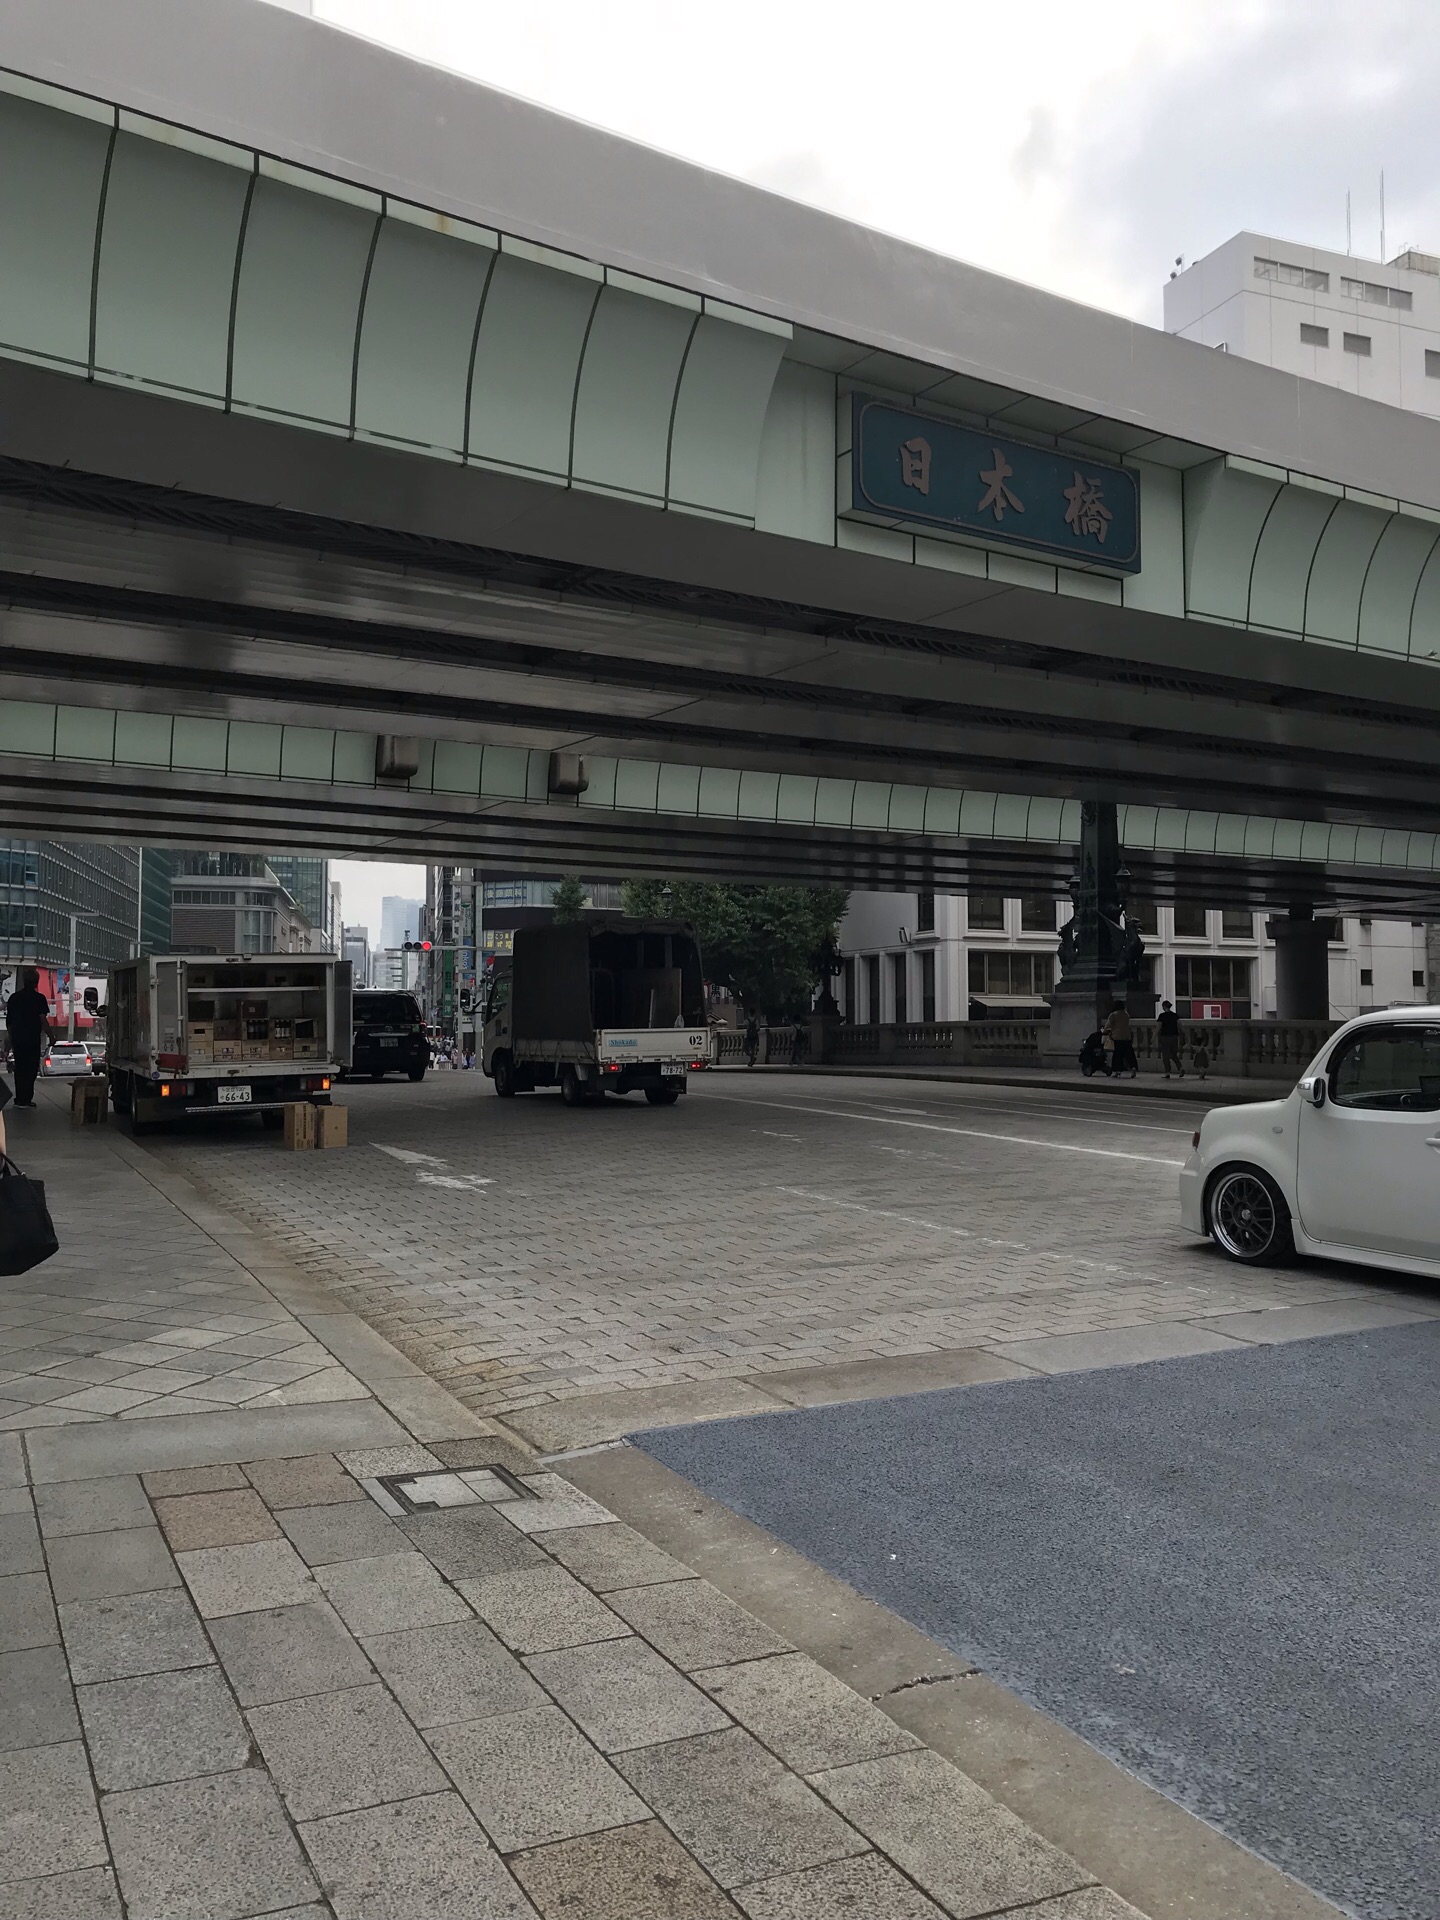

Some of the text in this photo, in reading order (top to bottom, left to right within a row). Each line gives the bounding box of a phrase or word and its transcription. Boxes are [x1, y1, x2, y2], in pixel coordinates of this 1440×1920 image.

[899, 436, 1113, 544] 日本橋
[689, 1035, 703, 1046] 02
[665, 1066, 683, 1074] 78-72
[225, 1092, 250, 1101] 66-43
